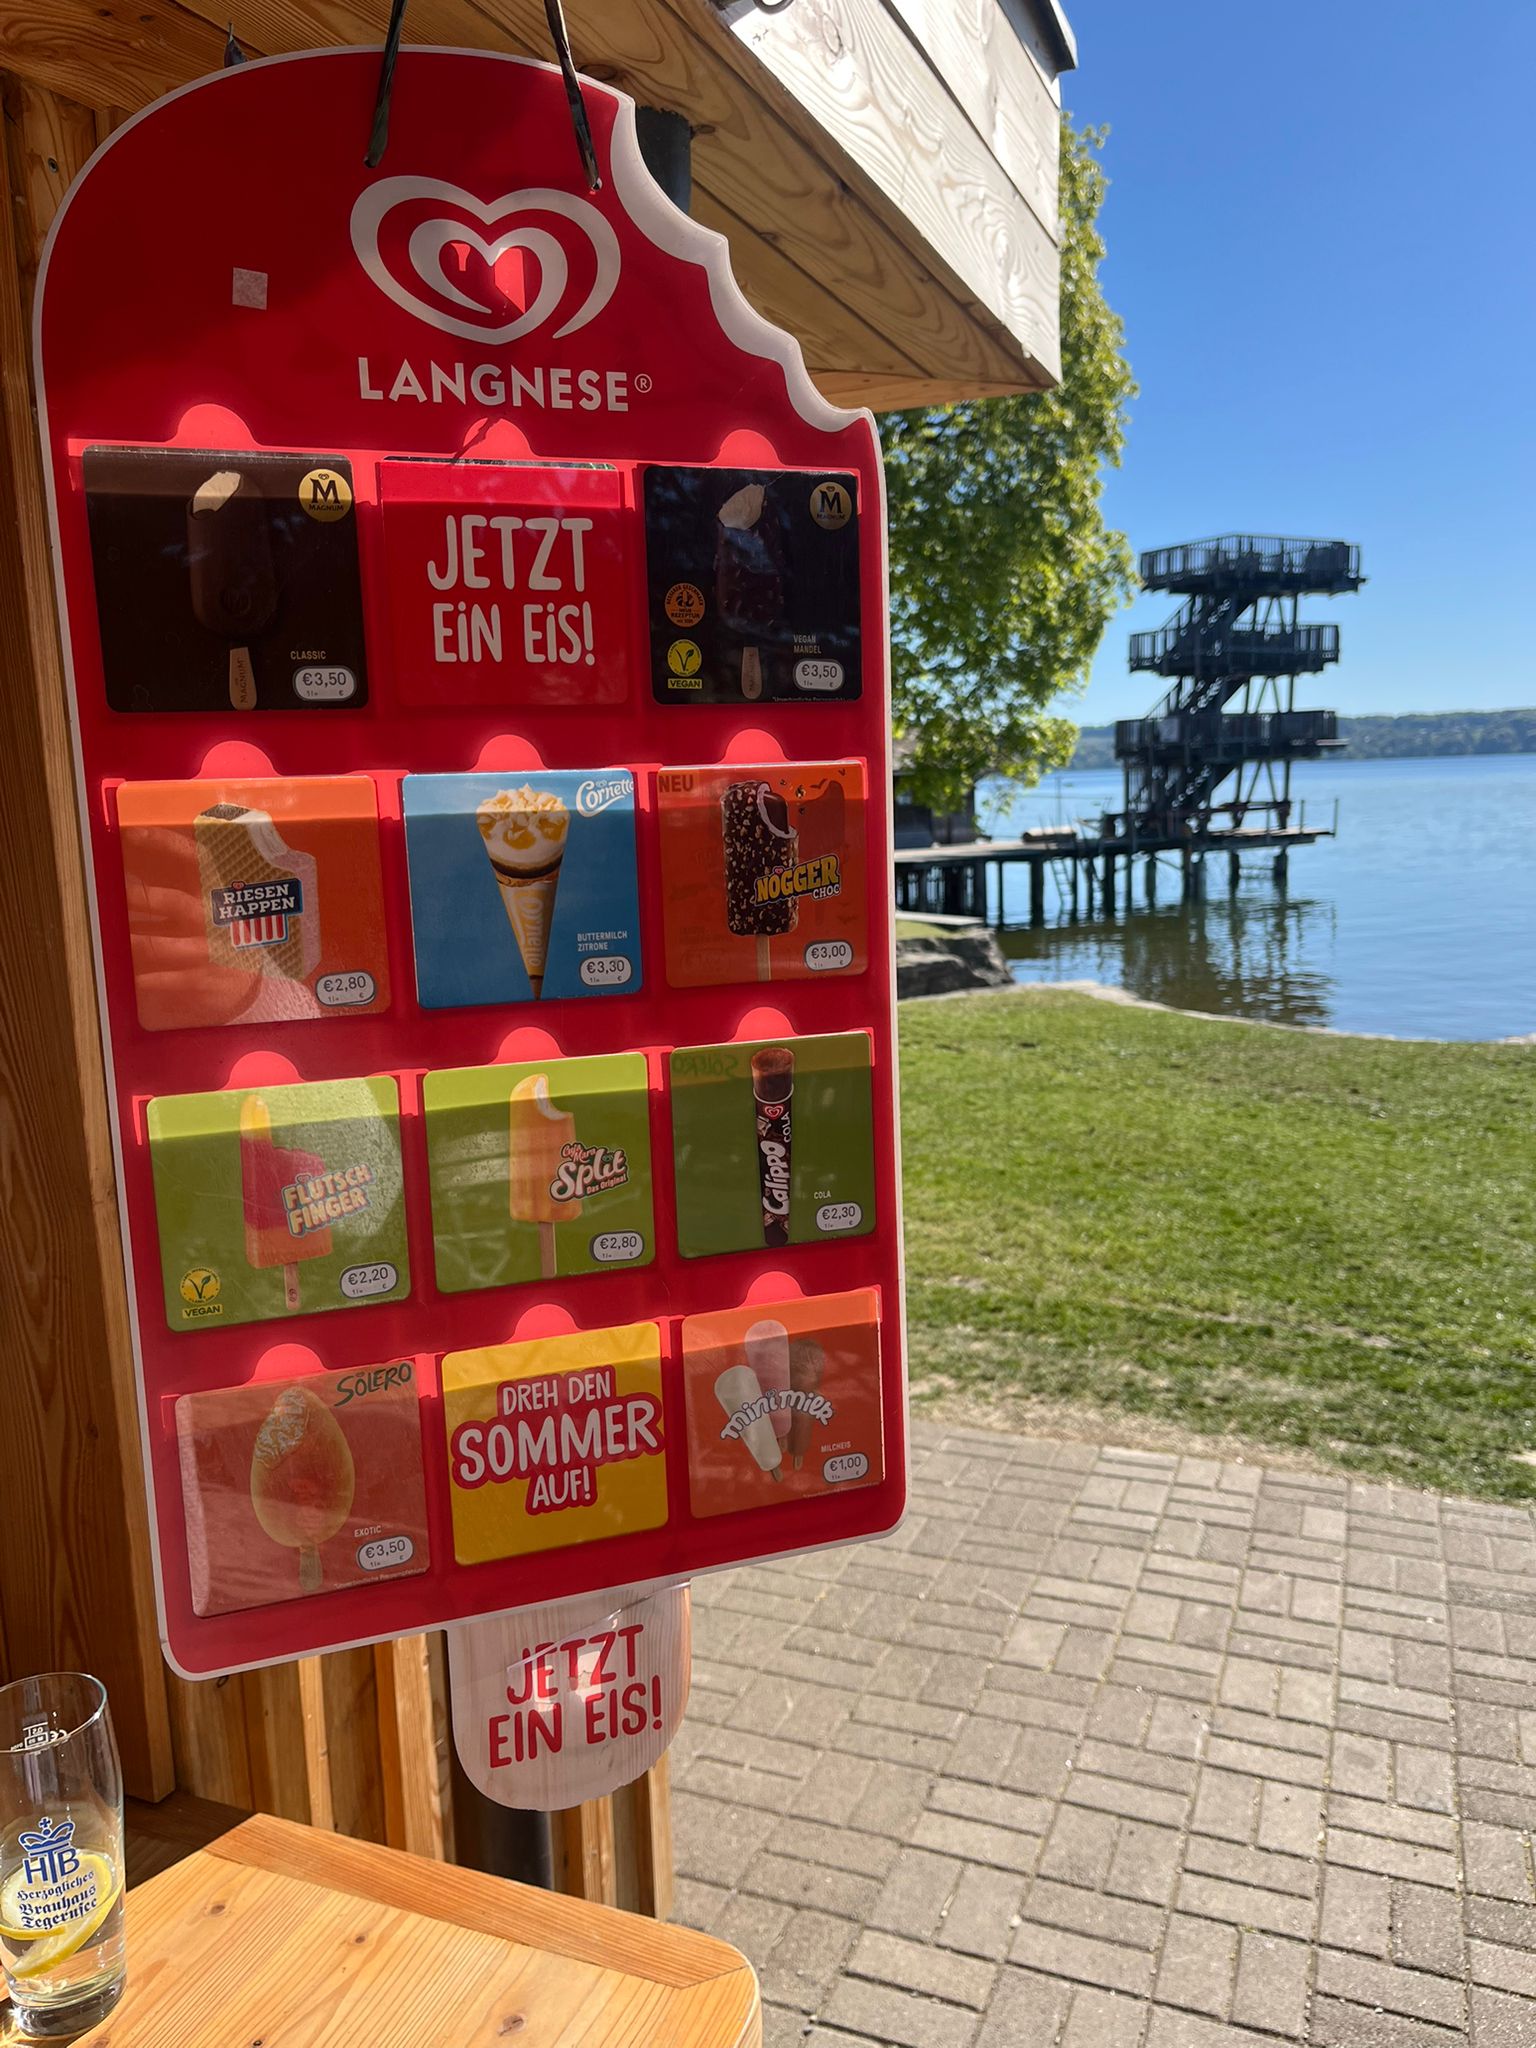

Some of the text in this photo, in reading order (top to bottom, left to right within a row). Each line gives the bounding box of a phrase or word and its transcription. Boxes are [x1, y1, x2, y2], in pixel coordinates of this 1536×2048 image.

[308, 503, 345, 513] MAGNUM
[426, 514, 594, 593] JETZT
[793, 634, 817, 643] VEGAN
[290, 650, 327, 661] CLASSIC
[793, 645, 822, 654] MANDEL
[302, 671, 347, 688] €3,50
[801, 663, 838, 678] €3,50
[669, 679, 701, 688] VEGAN
[658, 775, 694, 793] NEU
[756, 855, 840, 903] NOGGER
[222, 883, 290, 905] RIESEN
[812, 883, 840, 900] CHOC
[218, 896, 296, 921] HAPPEN
[576, 930, 628, 942] BUTTERMILCH
[577, 942, 609, 952] ZITRONE
[810, 944, 847, 960] €3,00
[586, 960, 625, 974] €3,30
[323, 975, 367, 994] €2,80
[782, 1111, 792, 1144] COLA
[550, 1148, 627, 1201] Split
[760, 1140, 791, 1216] Calippo
[284, 1163, 373, 1210] FLUTSCH
[813, 1190, 832, 1200] COLA
[289, 1188, 369, 1235] FINGER
[822, 1205, 856, 1221] €2,30
[599, 1235, 637, 1250] €2,80
[347, 1267, 389, 1287] €2,20
[184, 1305, 221, 1317] VEGAN
[502, 1370, 611, 1416] DREH DEN
[720, 1389, 833, 1440] mini milk
[459, 1400, 658, 1482] SOMMER
[820, 1441, 852, 1453] MILCHEIS
[829, 1456, 862, 1472] €1,00
[532, 1465, 591, 1509] AUF!
[354, 1525, 382, 1538] EXOTIC
[365, 1540, 406, 1560] €3,50
[506, 1624, 644, 1705] JETZT
[488, 1675, 663, 1769] EIN EIS!
[23, 1843, 80, 1885] HTB
[17, 1871, 95, 1901] Herzogliches
[19, 1884, 97, 1916] Brauhaus
